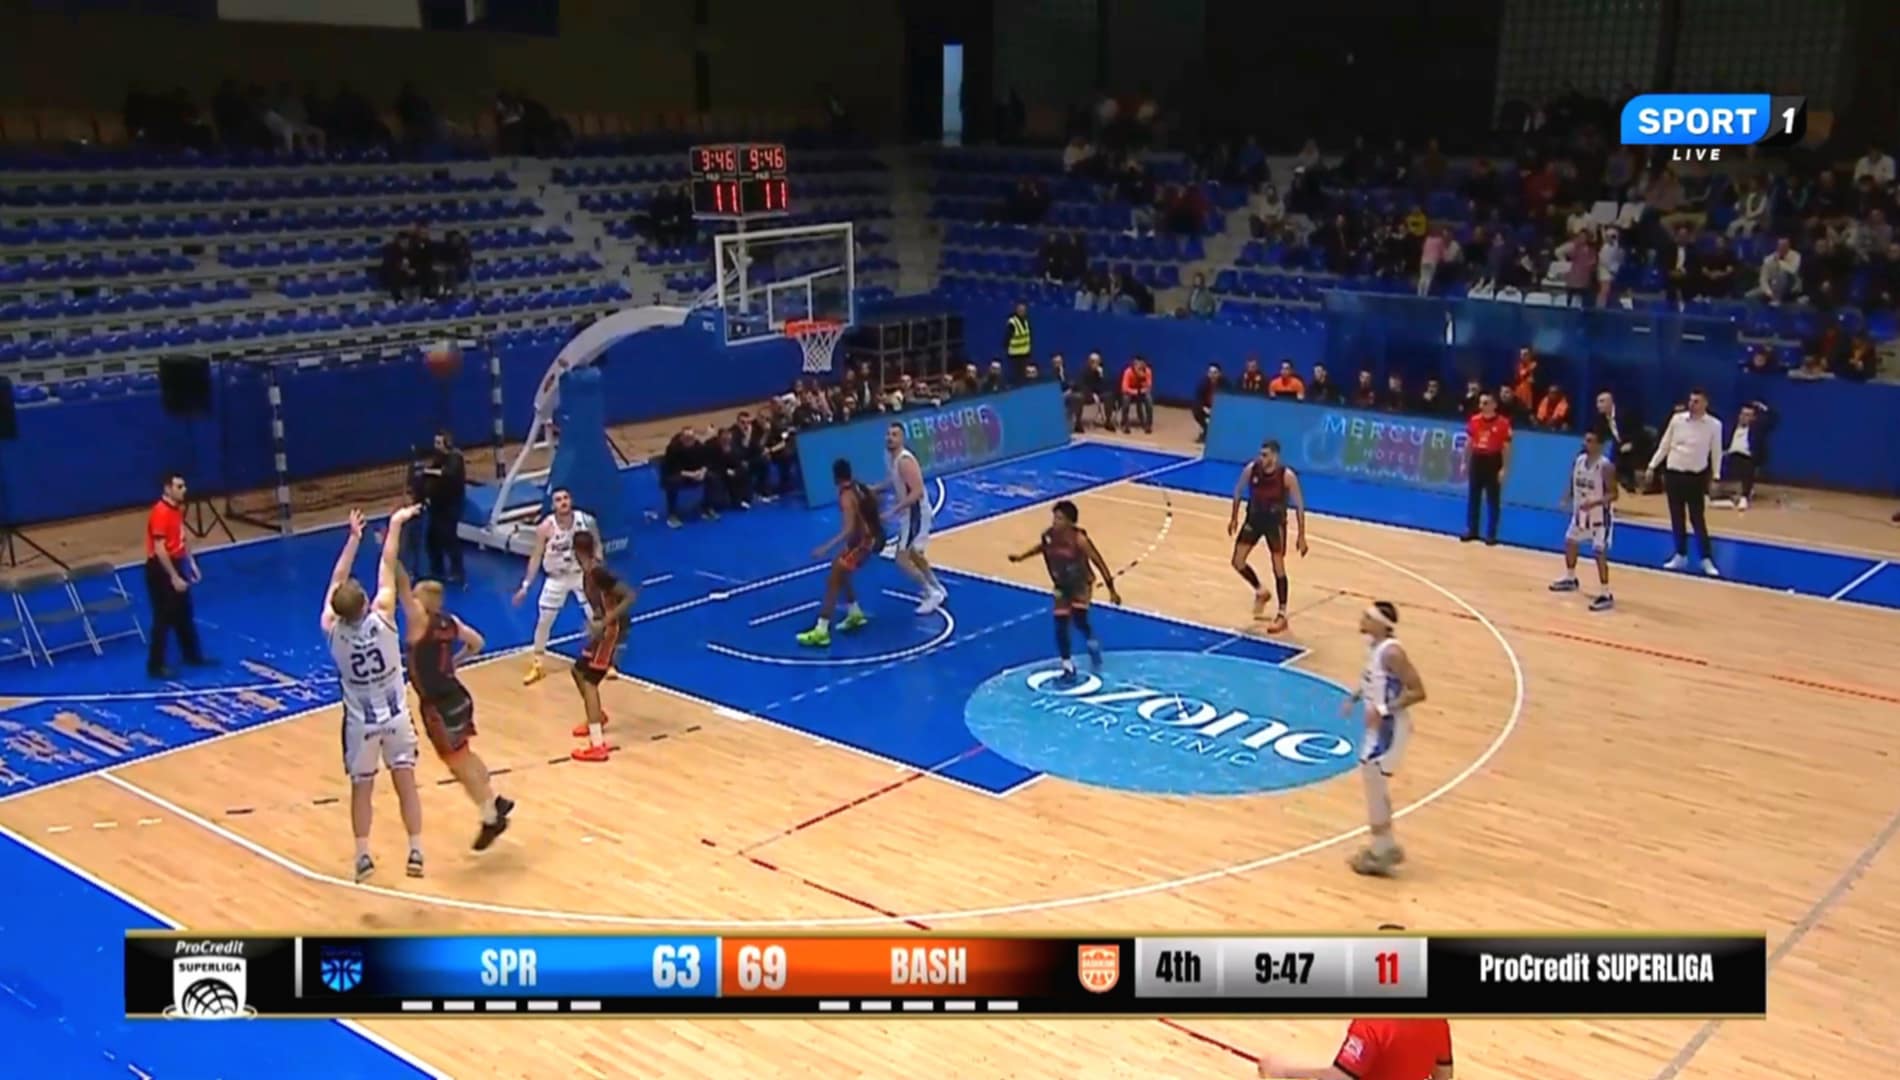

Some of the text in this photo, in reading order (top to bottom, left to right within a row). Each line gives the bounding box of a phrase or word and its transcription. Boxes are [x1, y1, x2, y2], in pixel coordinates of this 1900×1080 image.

[749, 147, 783, 170] 9:46
[716, 184, 737, 212] 11
[765, 182, 786, 209] 11
[351, 647, 386, 677] 23
[1031, 696, 1257, 768] HAIR CLINIC
